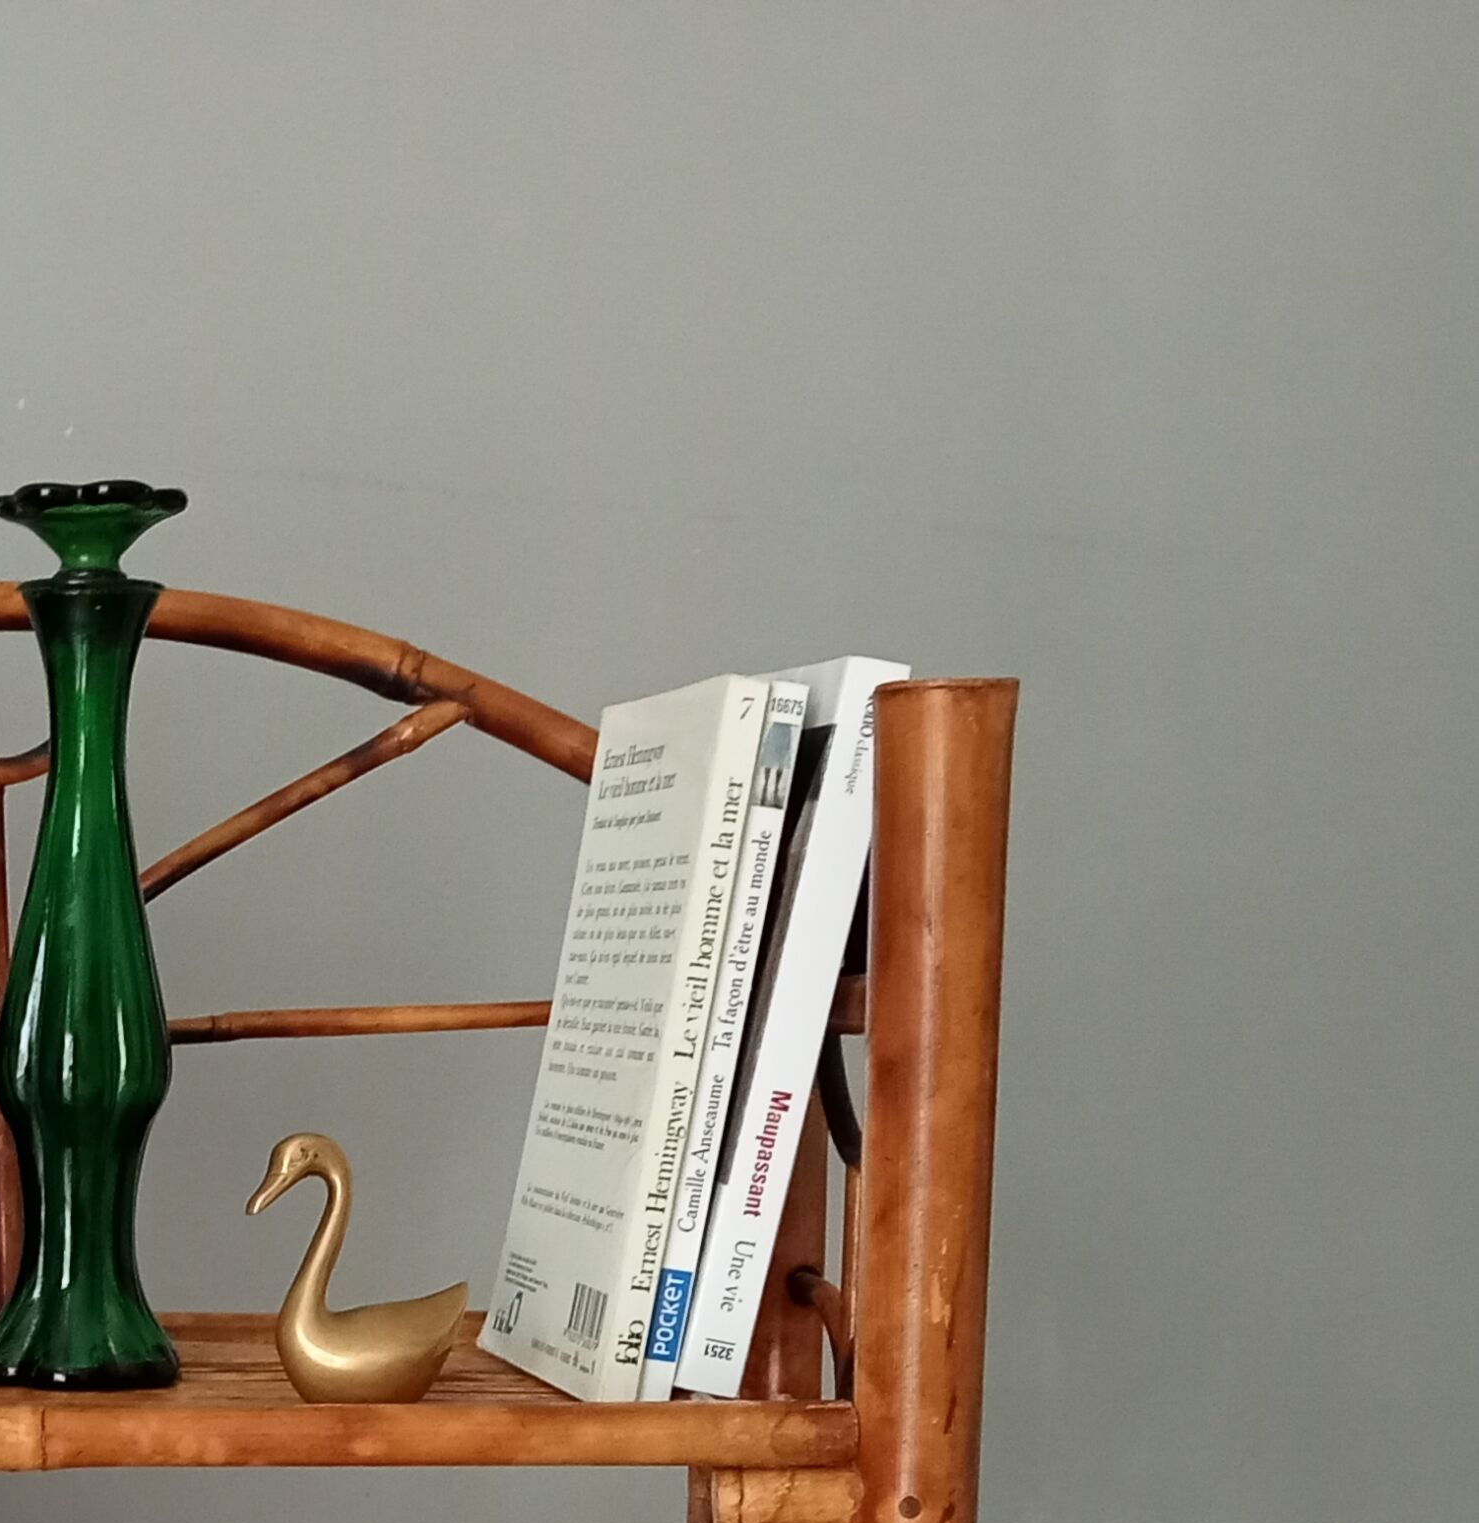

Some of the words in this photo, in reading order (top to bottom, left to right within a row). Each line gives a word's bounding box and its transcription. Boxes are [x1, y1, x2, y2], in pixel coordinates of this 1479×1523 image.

[739, 696, 755, 720] 7
[771, 696, 804, 717] 16675
[845, 739, 869, 795] classique
[721, 776, 745, 824] mer
[710, 831, 736, 851] la
[750, 829, 773, 890] monde
[711, 857, 730, 879] et
[689, 885, 725, 969] homme
[745, 893, 761, 920] au
[727, 921, 755, 972] d'être
[682, 973, 709, 1022] vieil
[717, 976, 745, 1025] façon
[673, 1028, 699, 1060] Le
[711, 1031, 734, 1052] Ta
[690, 1073, 726, 1164] Anseaume
[645, 1080, 694, 1214] Hemingway
[742, 1089, 794, 1218] Maupassant
[677, 1167, 707, 1233] Camille
[630, 1222, 664, 1294] Ernest
[727, 1239, 757, 1279] Une
[720, 1283, 743, 1313] vie
[614, 1318, 645, 1365] folio
[703, 1342, 734, 1362] 3251
